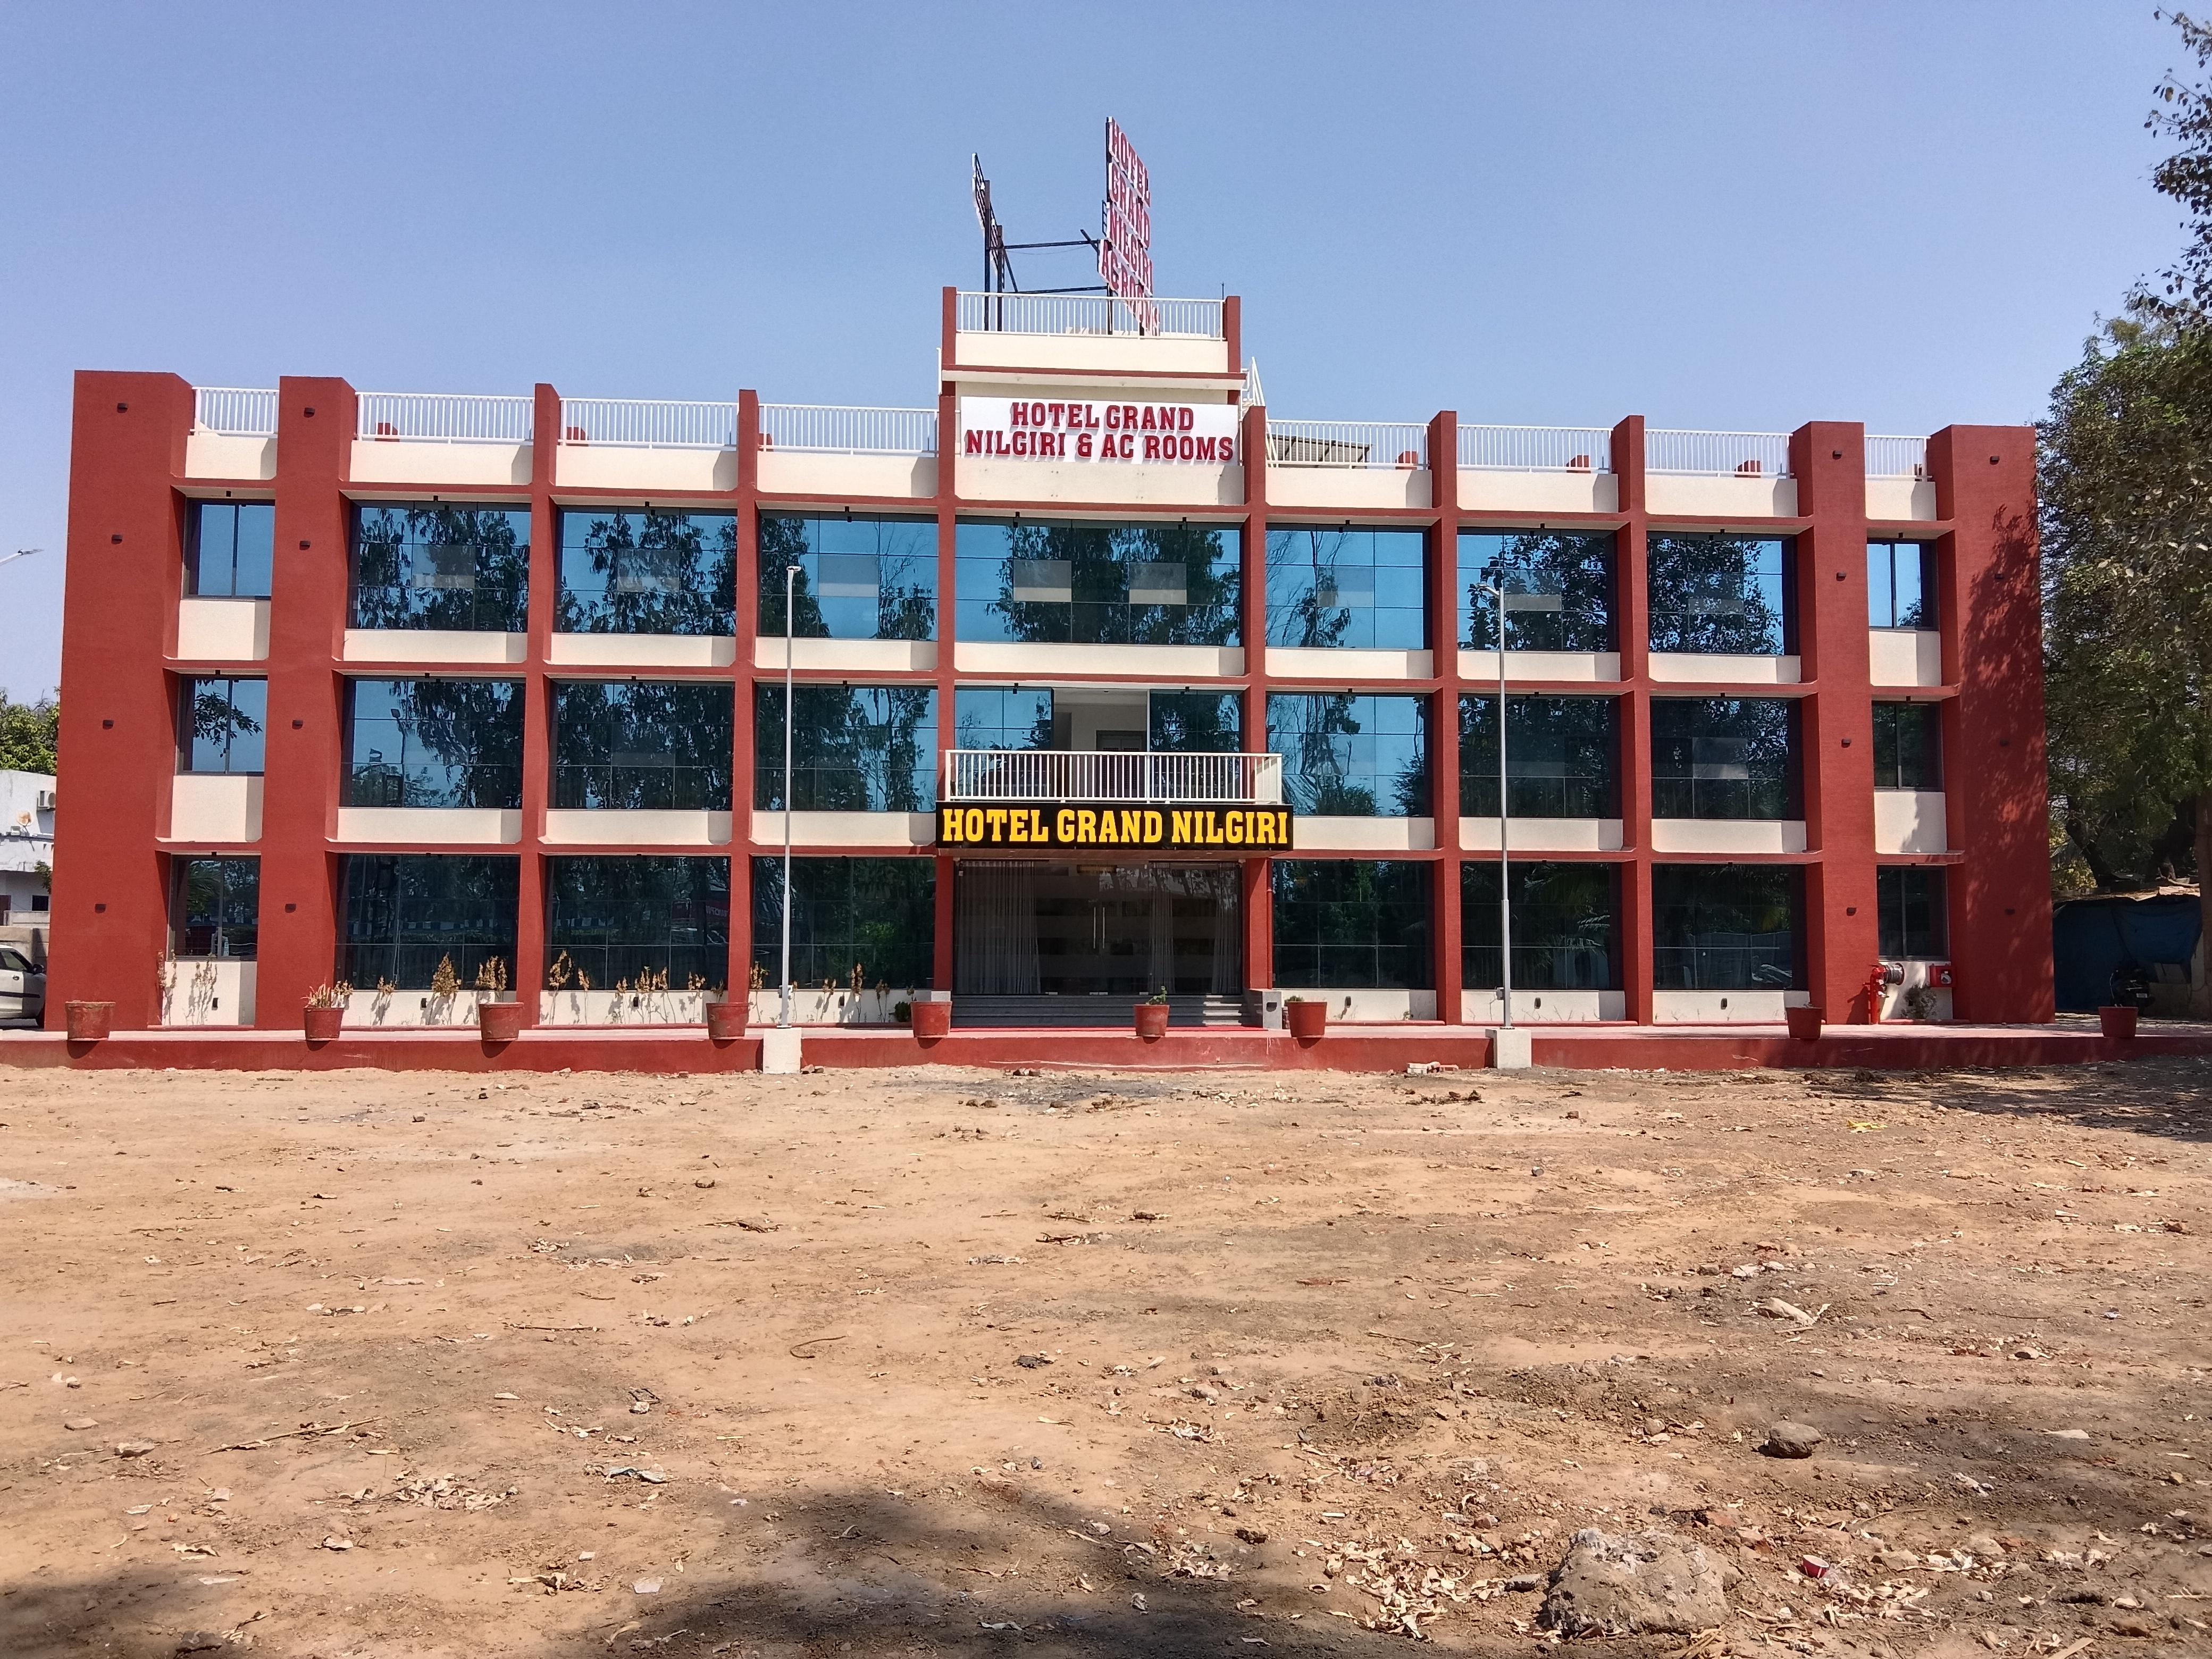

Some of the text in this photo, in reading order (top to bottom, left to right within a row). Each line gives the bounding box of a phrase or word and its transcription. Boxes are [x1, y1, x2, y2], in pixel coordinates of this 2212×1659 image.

[1109, 118, 1151, 208] HOTEL
[1109, 162, 1151, 249] GRAND
[1100, 239, 1119, 291] AC
[1108, 202, 1153, 296] NILGIRI
[1012, 402, 1194, 431] HOTEL GRAND
[966, 430, 1234, 462] NILGIRI & AC ROOMS
[943, 808, 1288, 844] HOTEL GRAND NILGIRI
